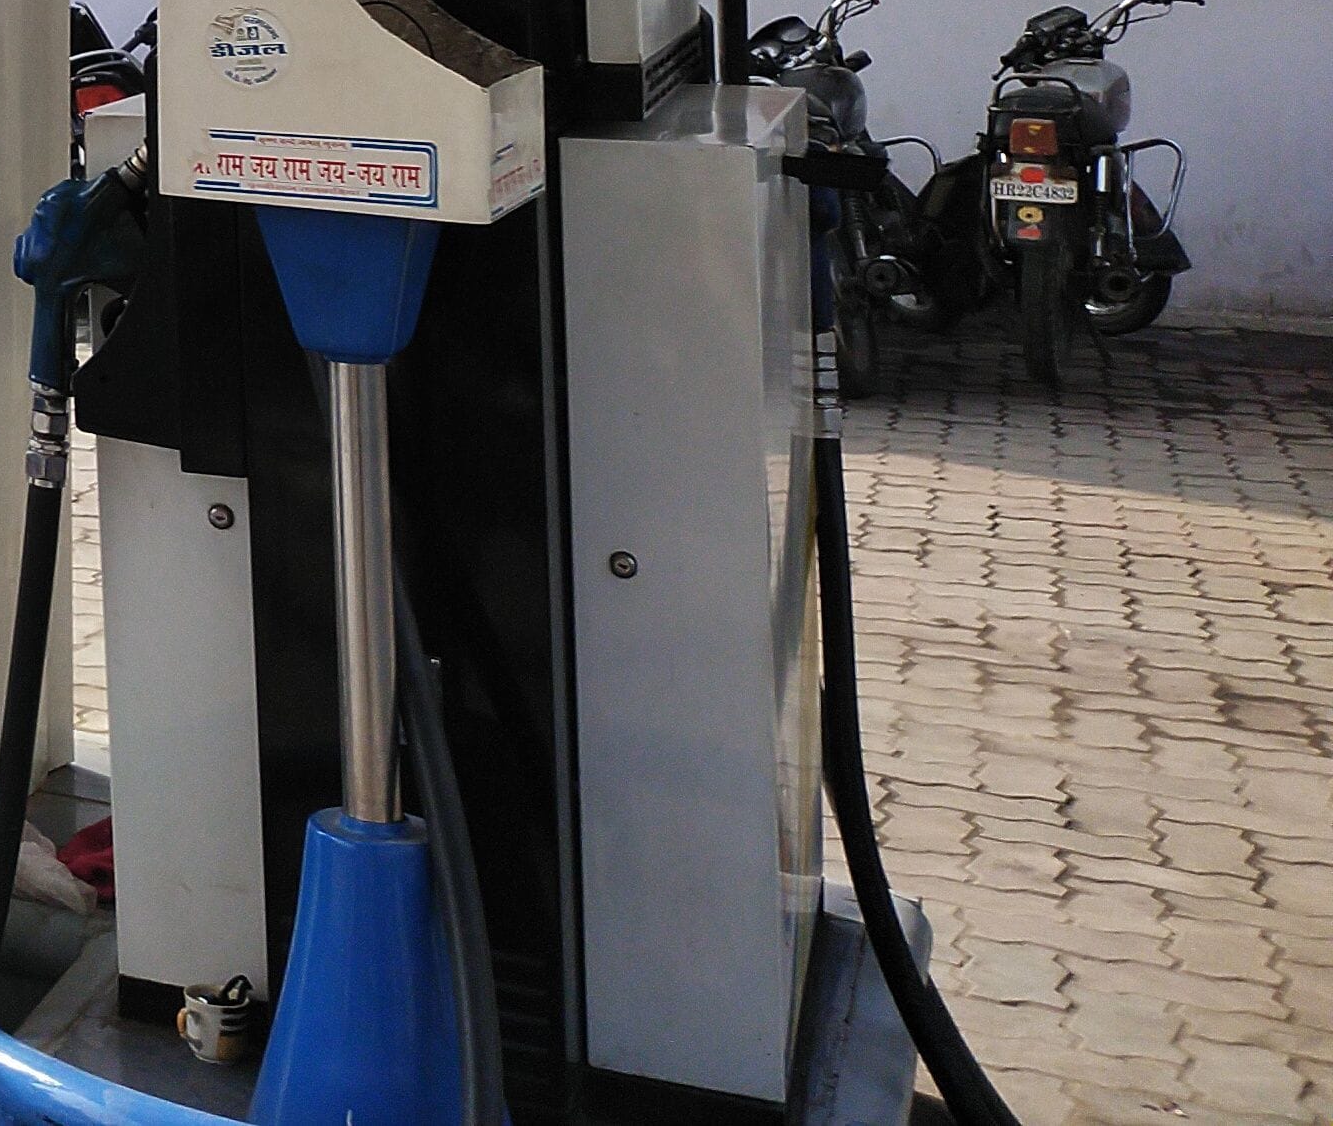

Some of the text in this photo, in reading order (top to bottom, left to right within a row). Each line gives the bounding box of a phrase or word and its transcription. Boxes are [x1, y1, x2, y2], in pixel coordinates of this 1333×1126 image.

[217, 153, 245, 177] राम
[249, 155, 279, 179] जय
[283, 158, 312, 182] राम
[391, 164, 422, 189] राम
